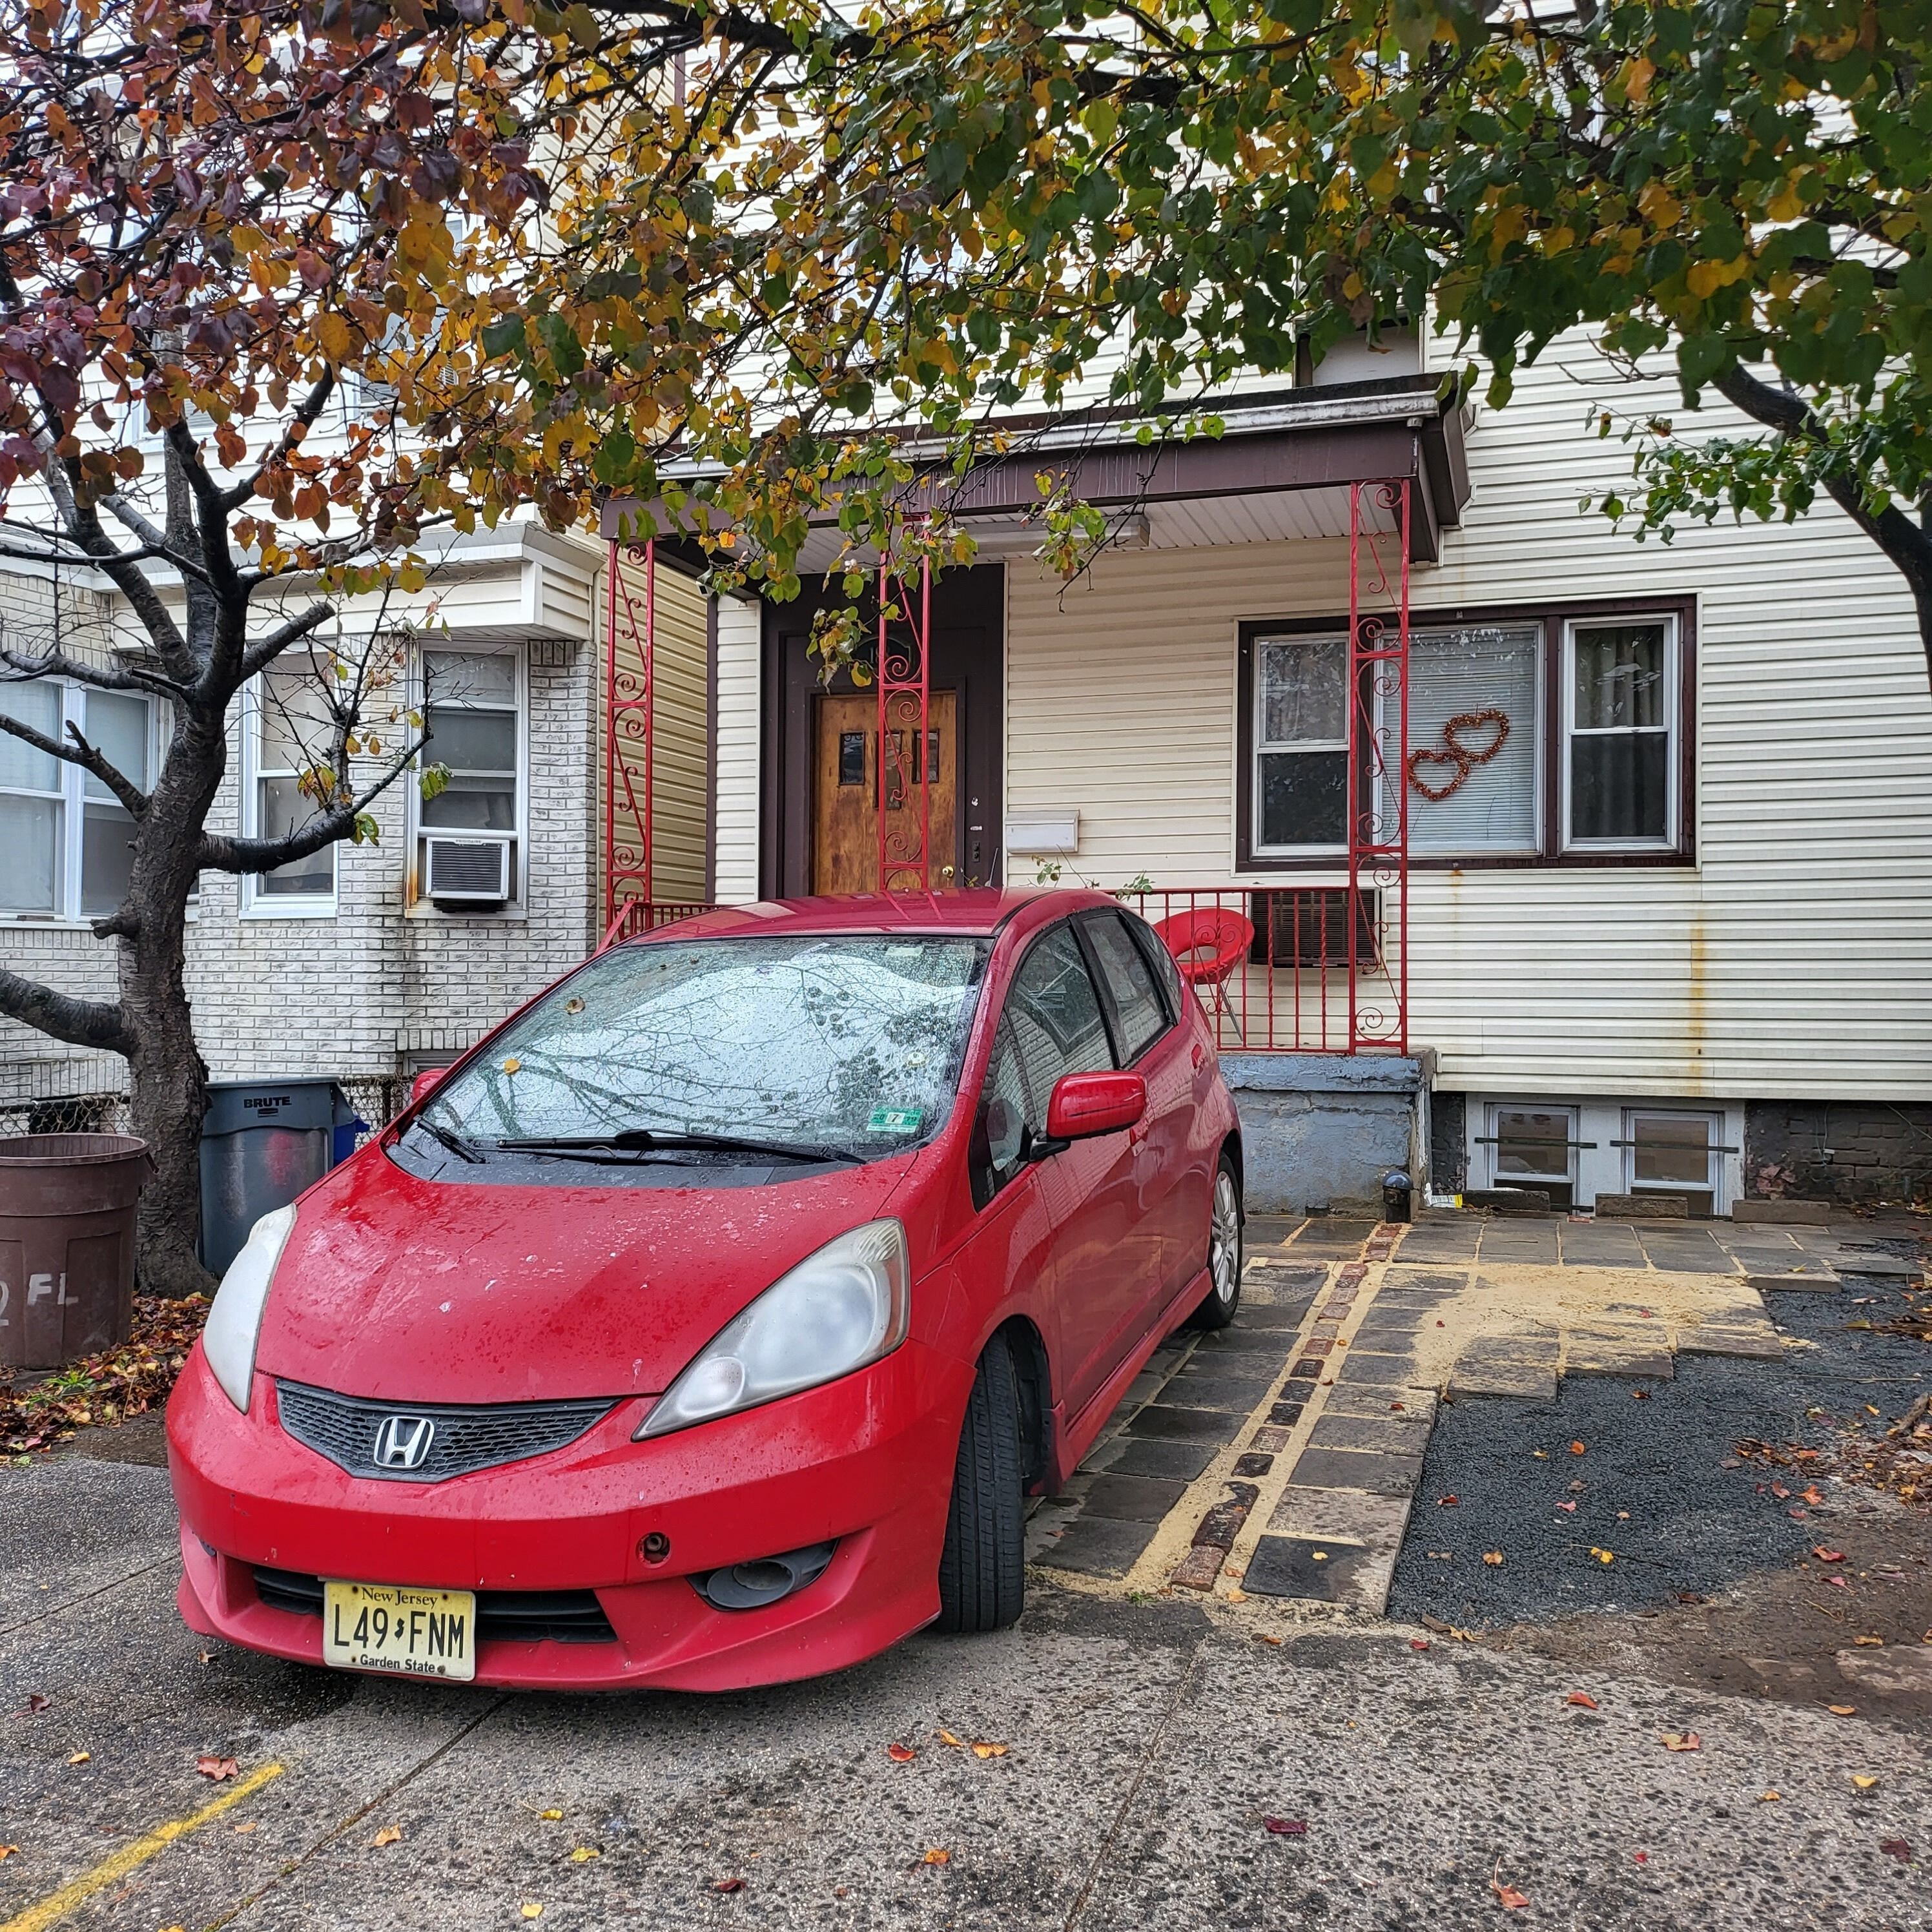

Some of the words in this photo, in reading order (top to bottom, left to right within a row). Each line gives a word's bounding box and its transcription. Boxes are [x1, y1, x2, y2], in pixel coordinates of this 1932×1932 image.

[243, 1096, 292, 1109] BRUTE
[891, 1114, 899, 1123] 7
[27, 1273, 79, 1306] FL
[361, 1587, 393, 1602] New
[395, 1590, 438, 1609] Jersey
[334, 1603, 388, 1650] L49
[409, 1610, 464, 1659] FNM
[360, 1654, 400, 1669] Garden
[405, 1658, 435, 1673] State
